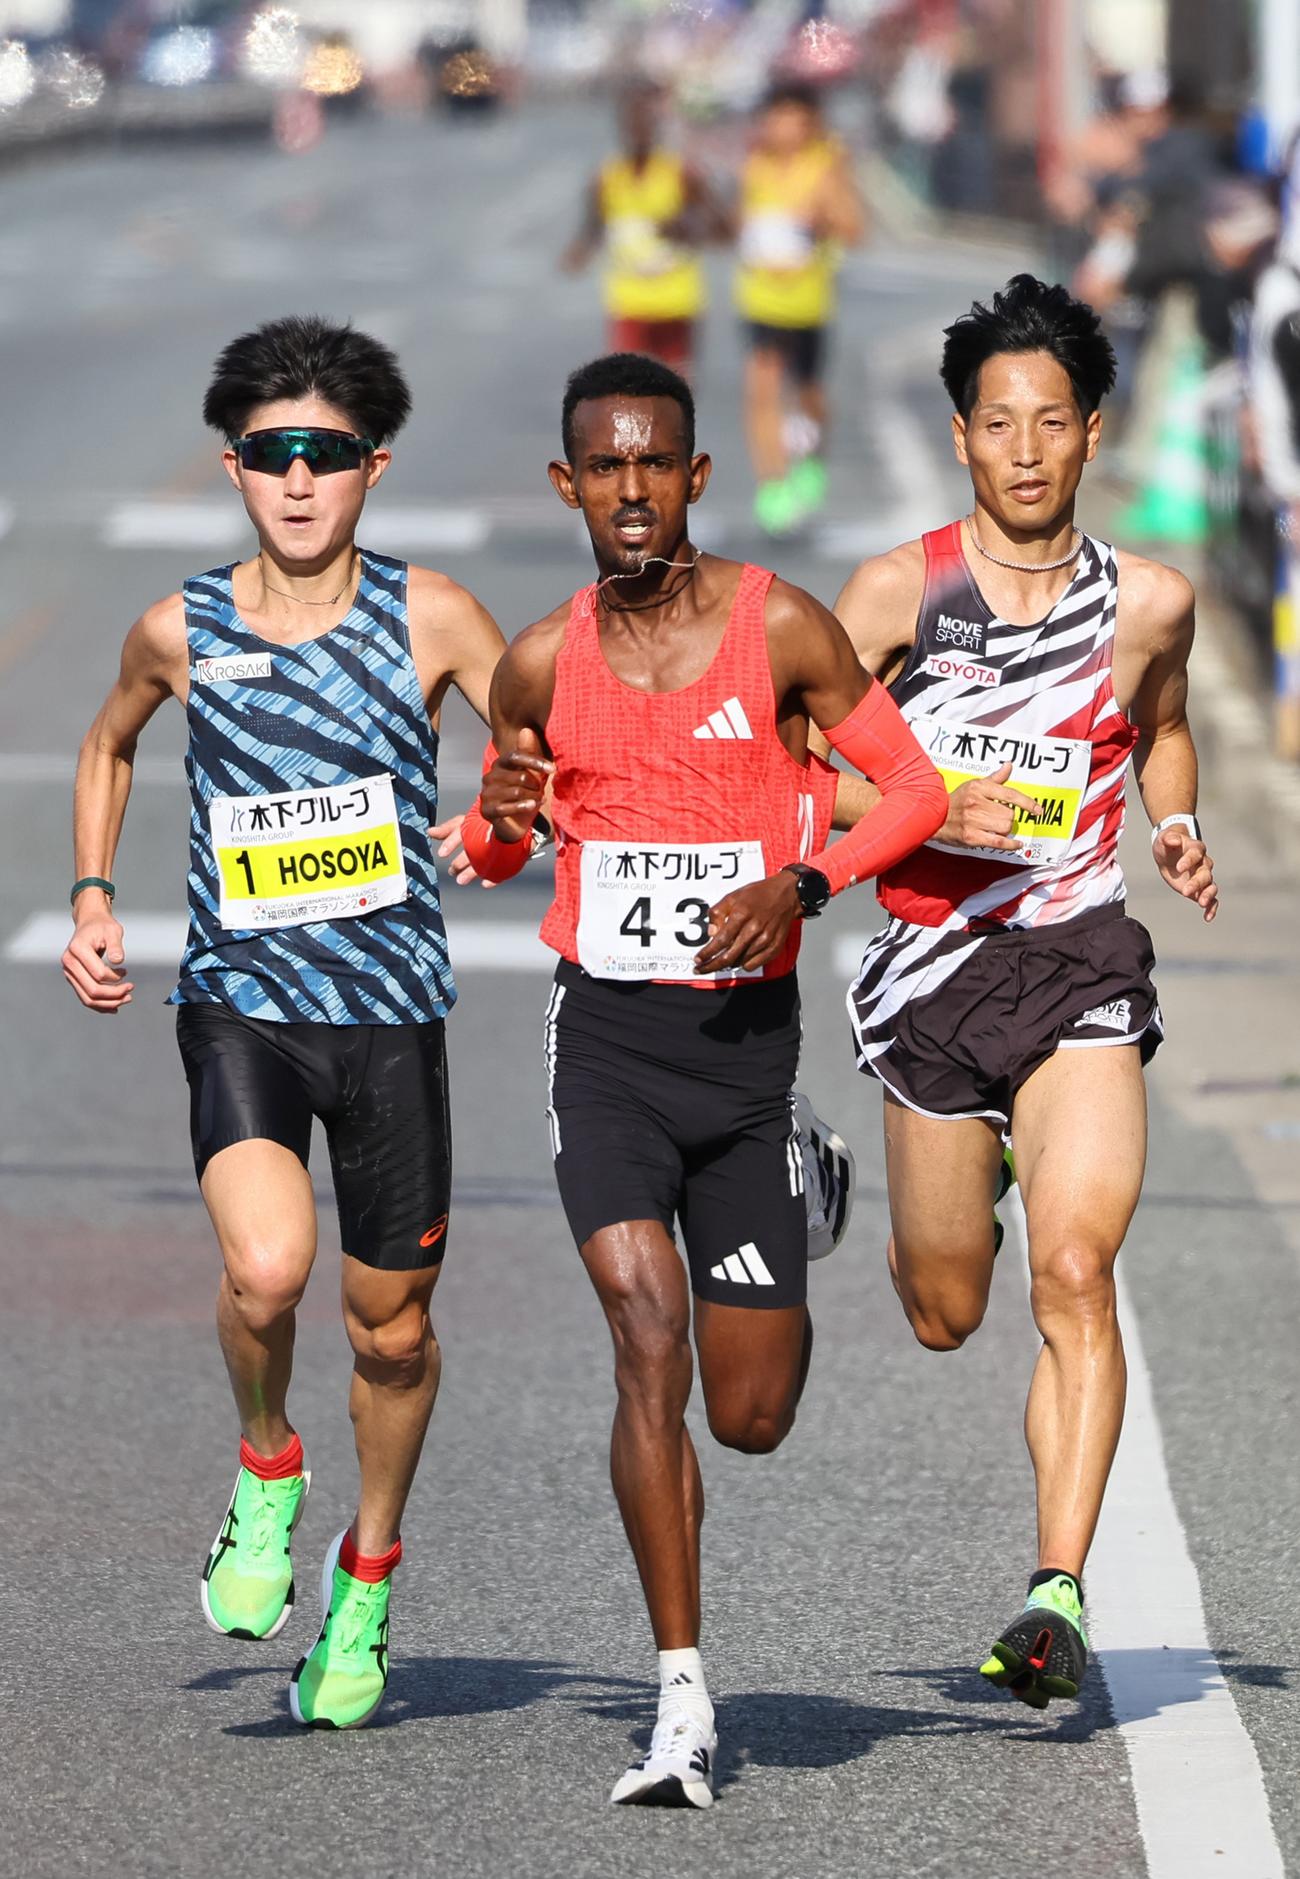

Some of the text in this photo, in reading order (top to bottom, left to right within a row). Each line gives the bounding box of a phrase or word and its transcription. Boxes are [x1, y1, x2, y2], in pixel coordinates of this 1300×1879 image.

[937, 614, 983, 638] MOVE
[935, 628, 982, 650] SPORT
[198, 660, 270, 682] KROSAKI
[929, 658, 996, 683] TOYOTA
[951, 732, 1074, 774] 木下グループ
[248, 786, 370, 831] 木下グループ
[267, 830, 295, 841] GROUP
[236, 840, 388, 895] 1 HOSOYA
[616, 849, 743, 880] 木下グループ
